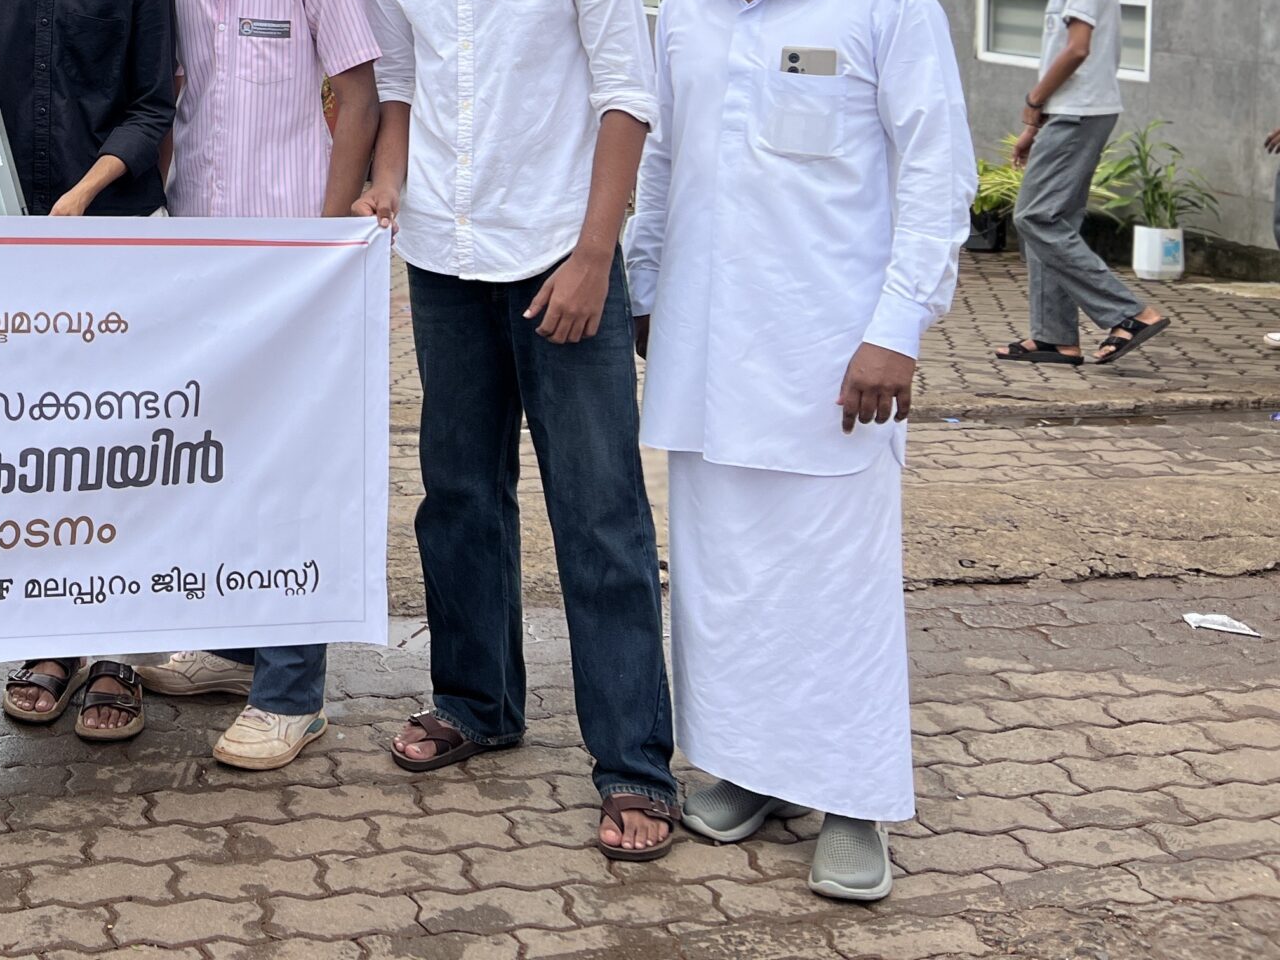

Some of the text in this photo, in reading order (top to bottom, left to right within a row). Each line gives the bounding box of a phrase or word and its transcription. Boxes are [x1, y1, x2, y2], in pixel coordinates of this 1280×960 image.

[24, 574, 141, 605] മലപ്പുറം
[150, 565, 206, 600] ജില്ല
[215, 559, 320, 597] (വെസ്റ്റ്)
